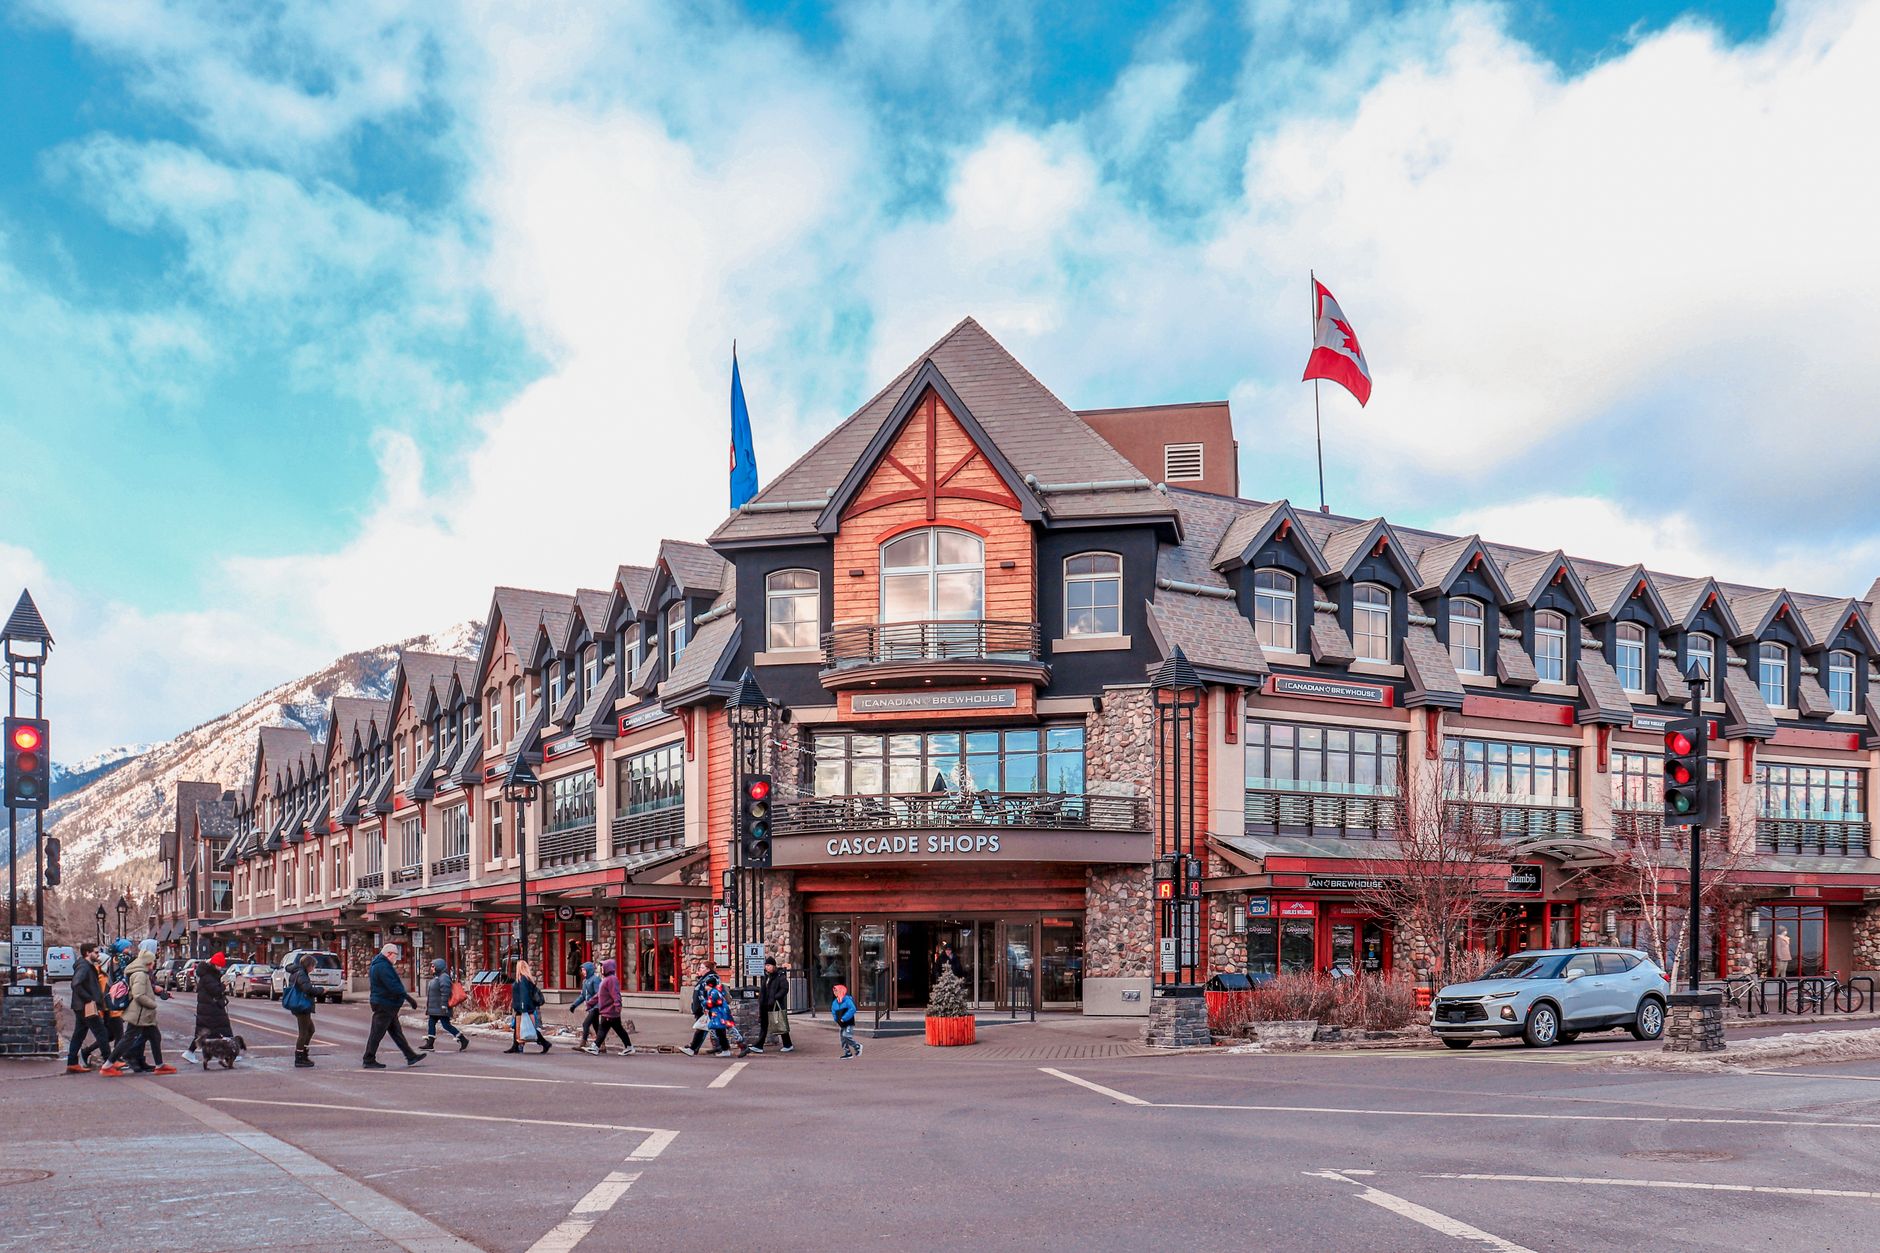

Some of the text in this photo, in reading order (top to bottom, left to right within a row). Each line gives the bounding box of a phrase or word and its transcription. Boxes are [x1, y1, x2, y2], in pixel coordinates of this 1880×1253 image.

[1288, 682, 1376, 698] CANADIAN BREWHOUSE
[864, 698, 921, 708] CANADIAN
[932, 694, 1006, 705] BREWHOUSE
[826, 835, 1000, 856] CASCADE SHOPS
[1330, 880, 1383, 888] BREWHOUSE
